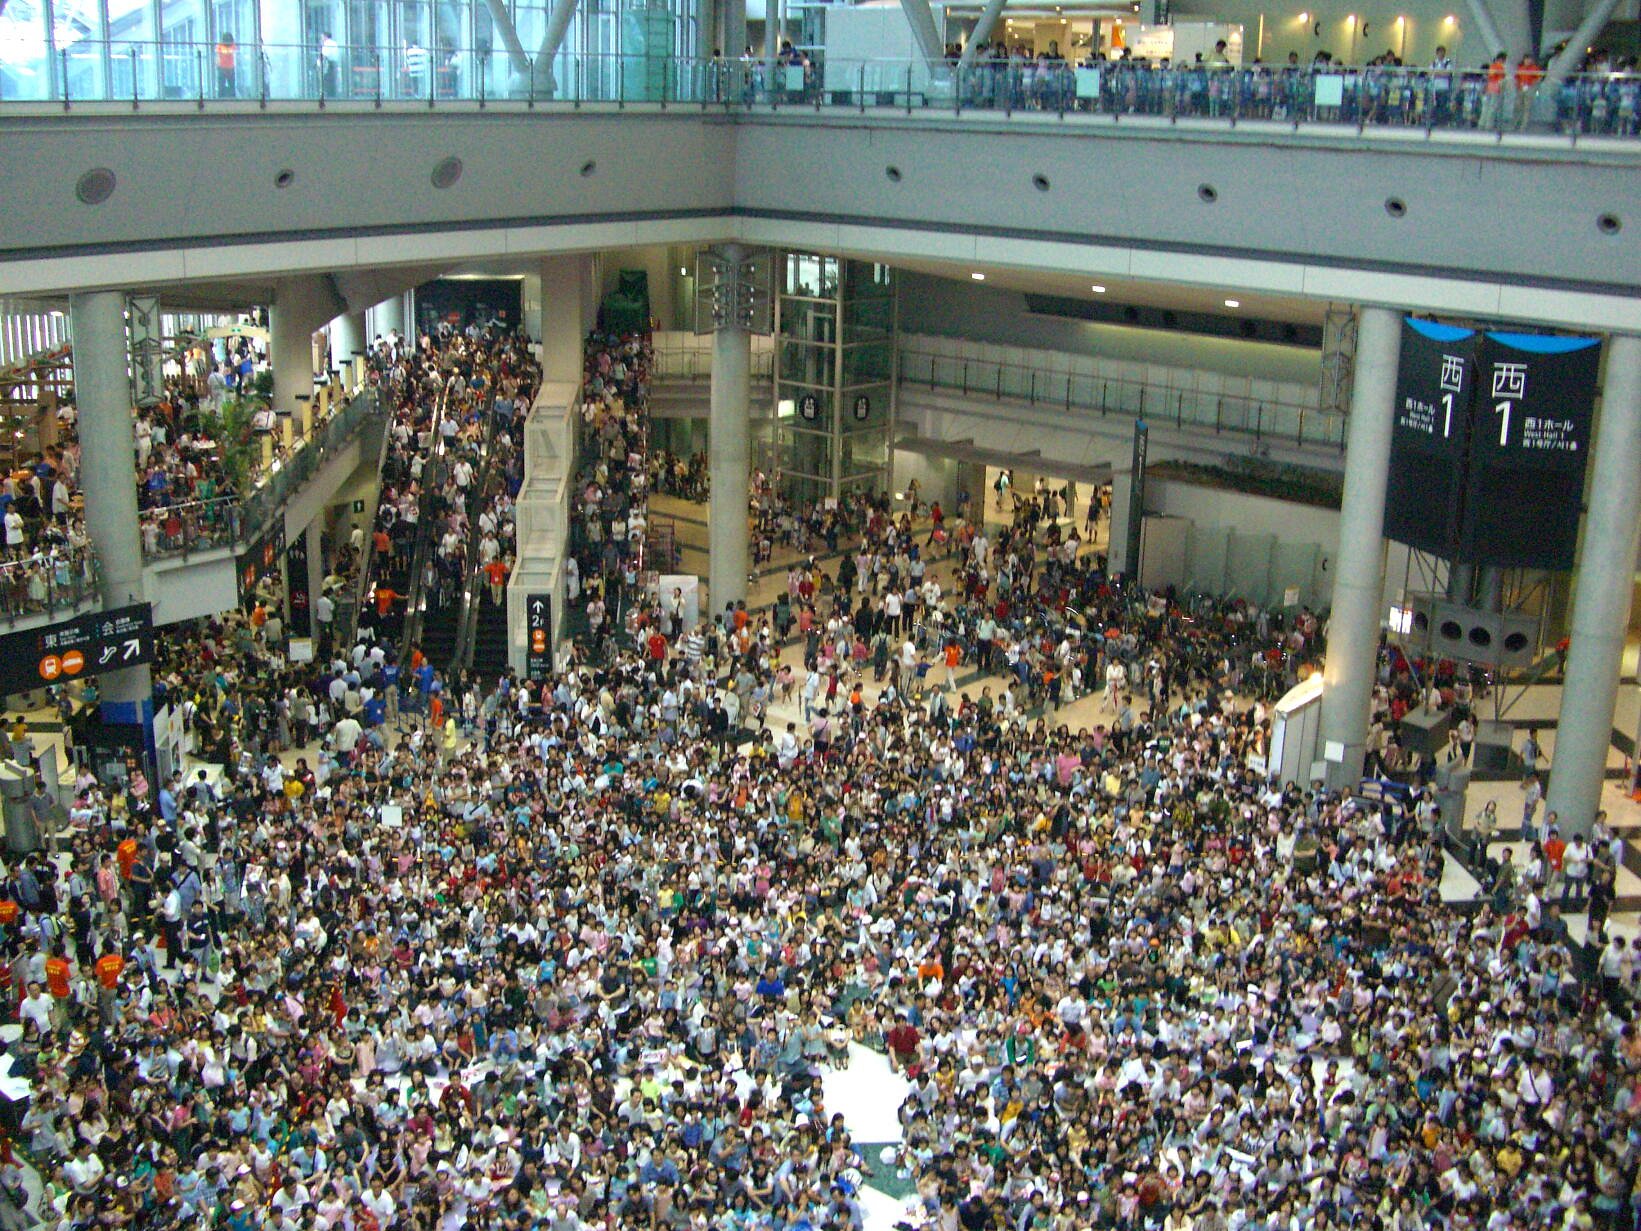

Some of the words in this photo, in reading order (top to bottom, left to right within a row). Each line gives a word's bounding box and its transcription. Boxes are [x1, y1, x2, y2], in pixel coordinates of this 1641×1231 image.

[1440, 354, 1464, 393] 西
[1492, 362, 1527, 400] 西
[1442, 393, 1453, 438] 1
[1495, 401, 1511, 446] 1
